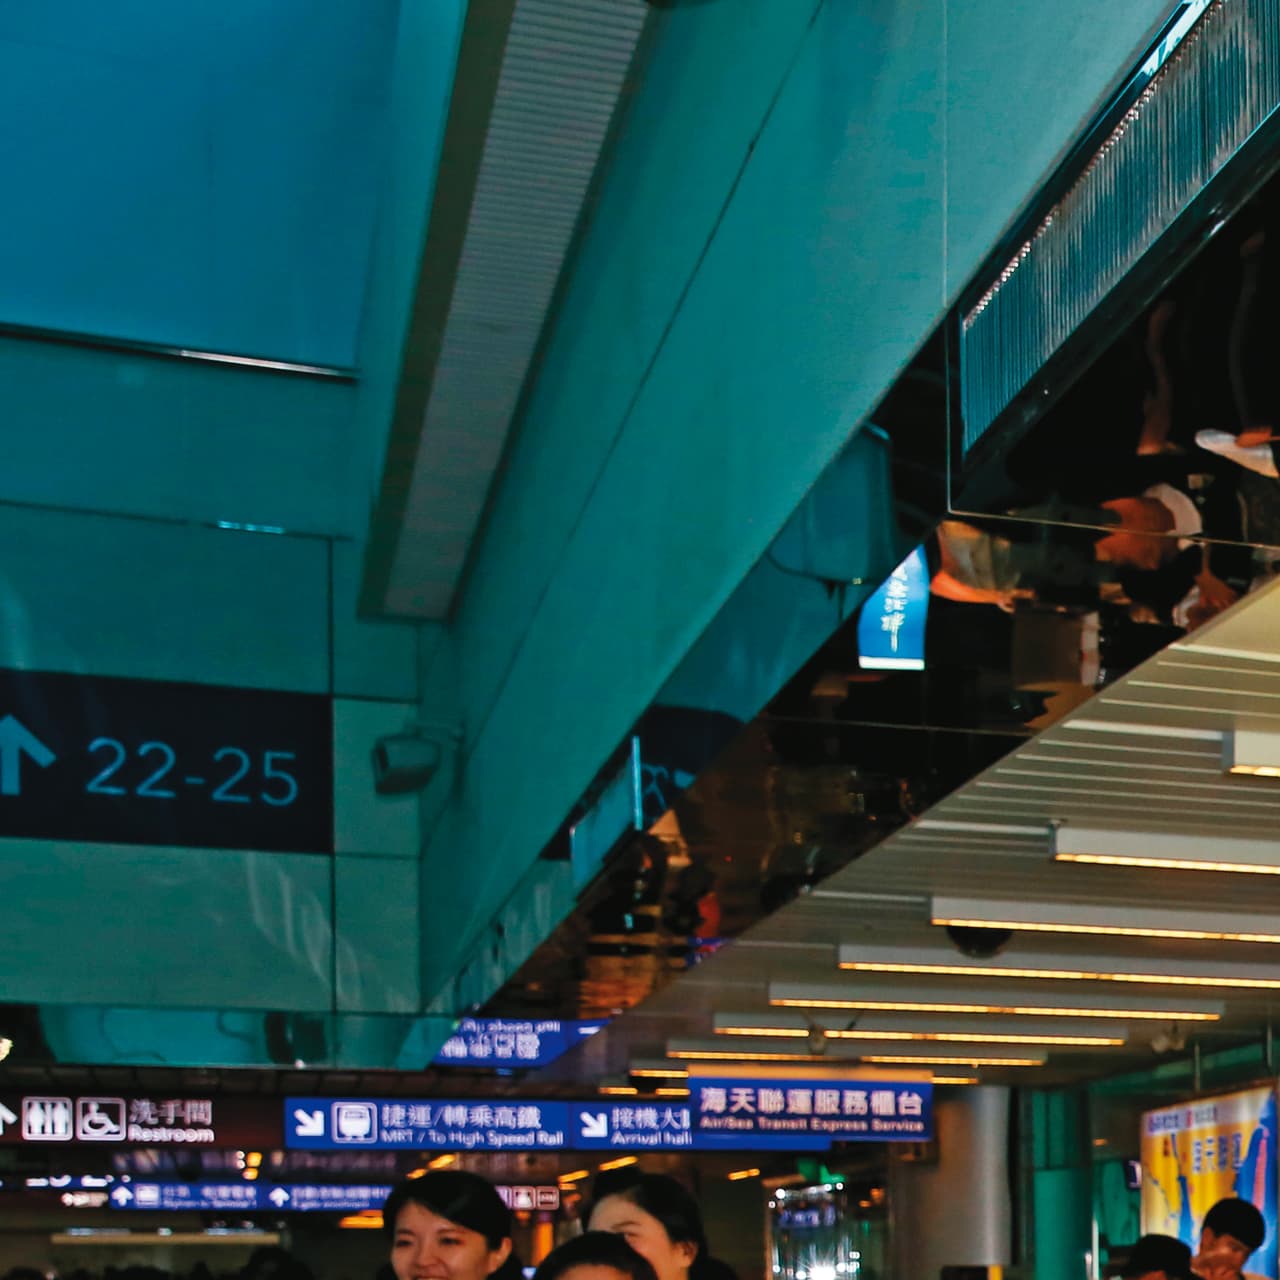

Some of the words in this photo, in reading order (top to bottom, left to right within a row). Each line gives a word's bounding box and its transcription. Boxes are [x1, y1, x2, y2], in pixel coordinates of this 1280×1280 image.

[85, 738, 300, 807] 22-25
[127, 1125, 215, 1143] Restroom
[811, 1118, 868, 1133] Express
[872, 1119, 924, 1133] Service
[381, 1130, 414, 1144] MRT
[429, 1130, 446, 1144] To
[448, 1130, 485, 1146] High
[487, 1131, 534, 1147] Speed
[537, 1131, 564, 1146] Rail
[611, 1130, 662, 1146] Arrival
